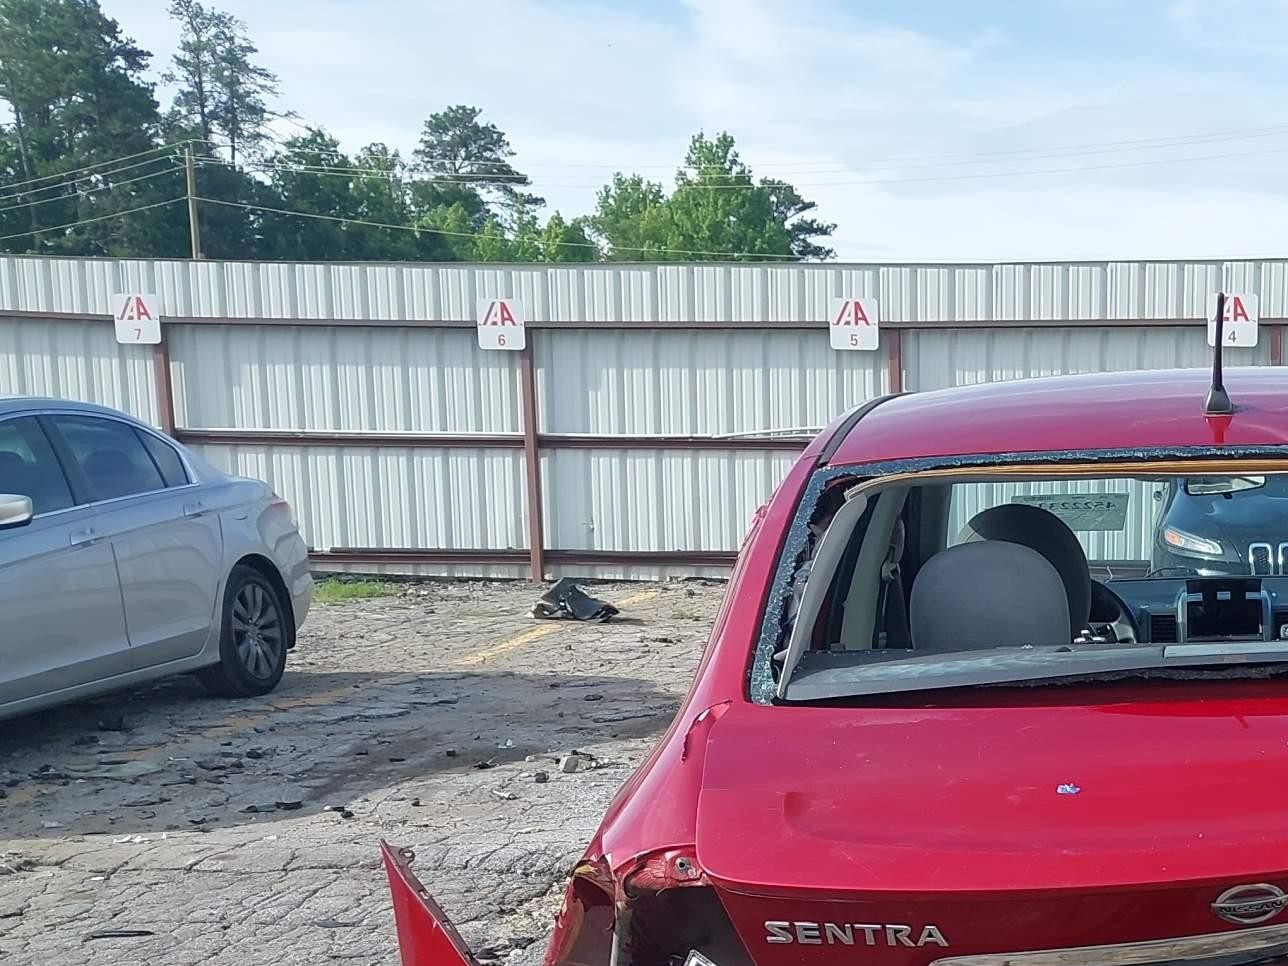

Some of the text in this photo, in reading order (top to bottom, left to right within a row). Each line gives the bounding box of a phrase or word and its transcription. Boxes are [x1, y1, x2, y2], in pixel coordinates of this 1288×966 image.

[134, 328, 142, 340] 7
[498, 334, 506, 346] 6
[850, 334, 858, 346] 5
[1228, 330, 1237, 343] 4
[1220, 899, 1284, 913] NISSAN
[764, 921, 950, 947] SENTRA
